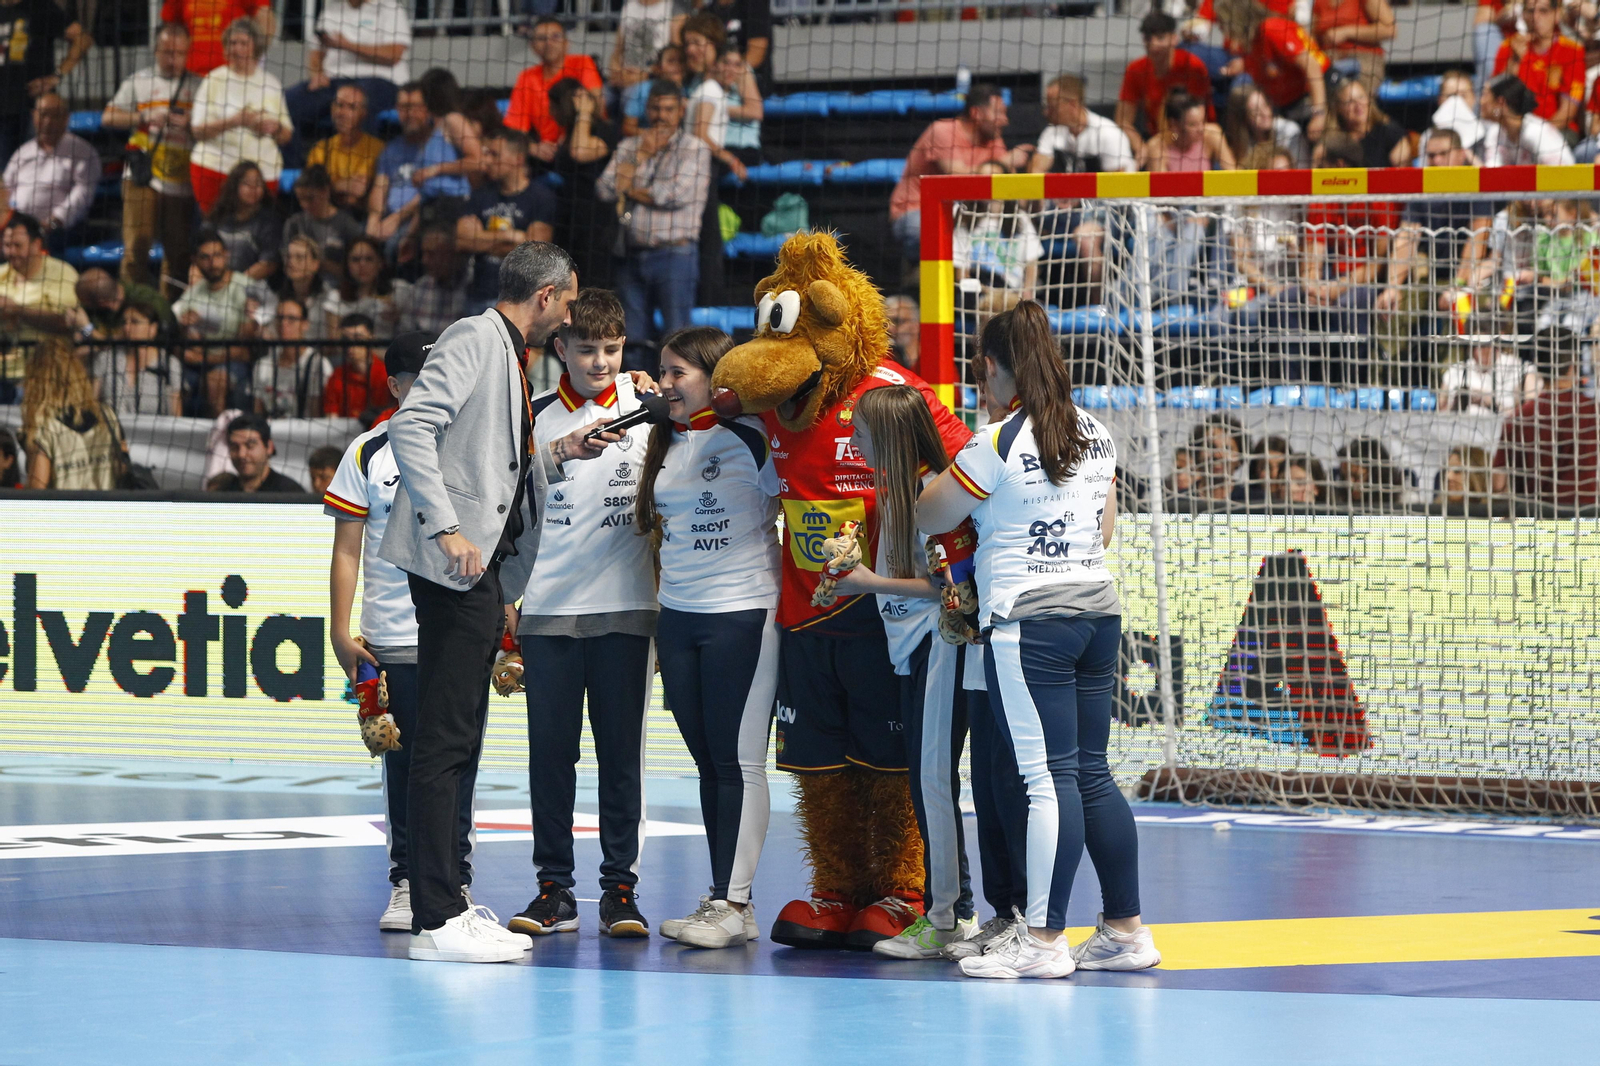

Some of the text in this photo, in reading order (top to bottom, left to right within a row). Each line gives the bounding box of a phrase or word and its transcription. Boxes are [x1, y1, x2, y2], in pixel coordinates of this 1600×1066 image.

[608, 479, 637, 487] Correos
[1023, 490, 1080, 505] HISPANITAS
[694, 507, 725, 515] Correos
[1064, 510, 1075, 522] fit
[600, 512, 635, 528] AVIS
[693, 537, 731, 551] AVIS
[953, 533, 972, 550] 25
[1027, 564, 1072, 574] MELILLA
[0, 573, 326, 702] lvetia
